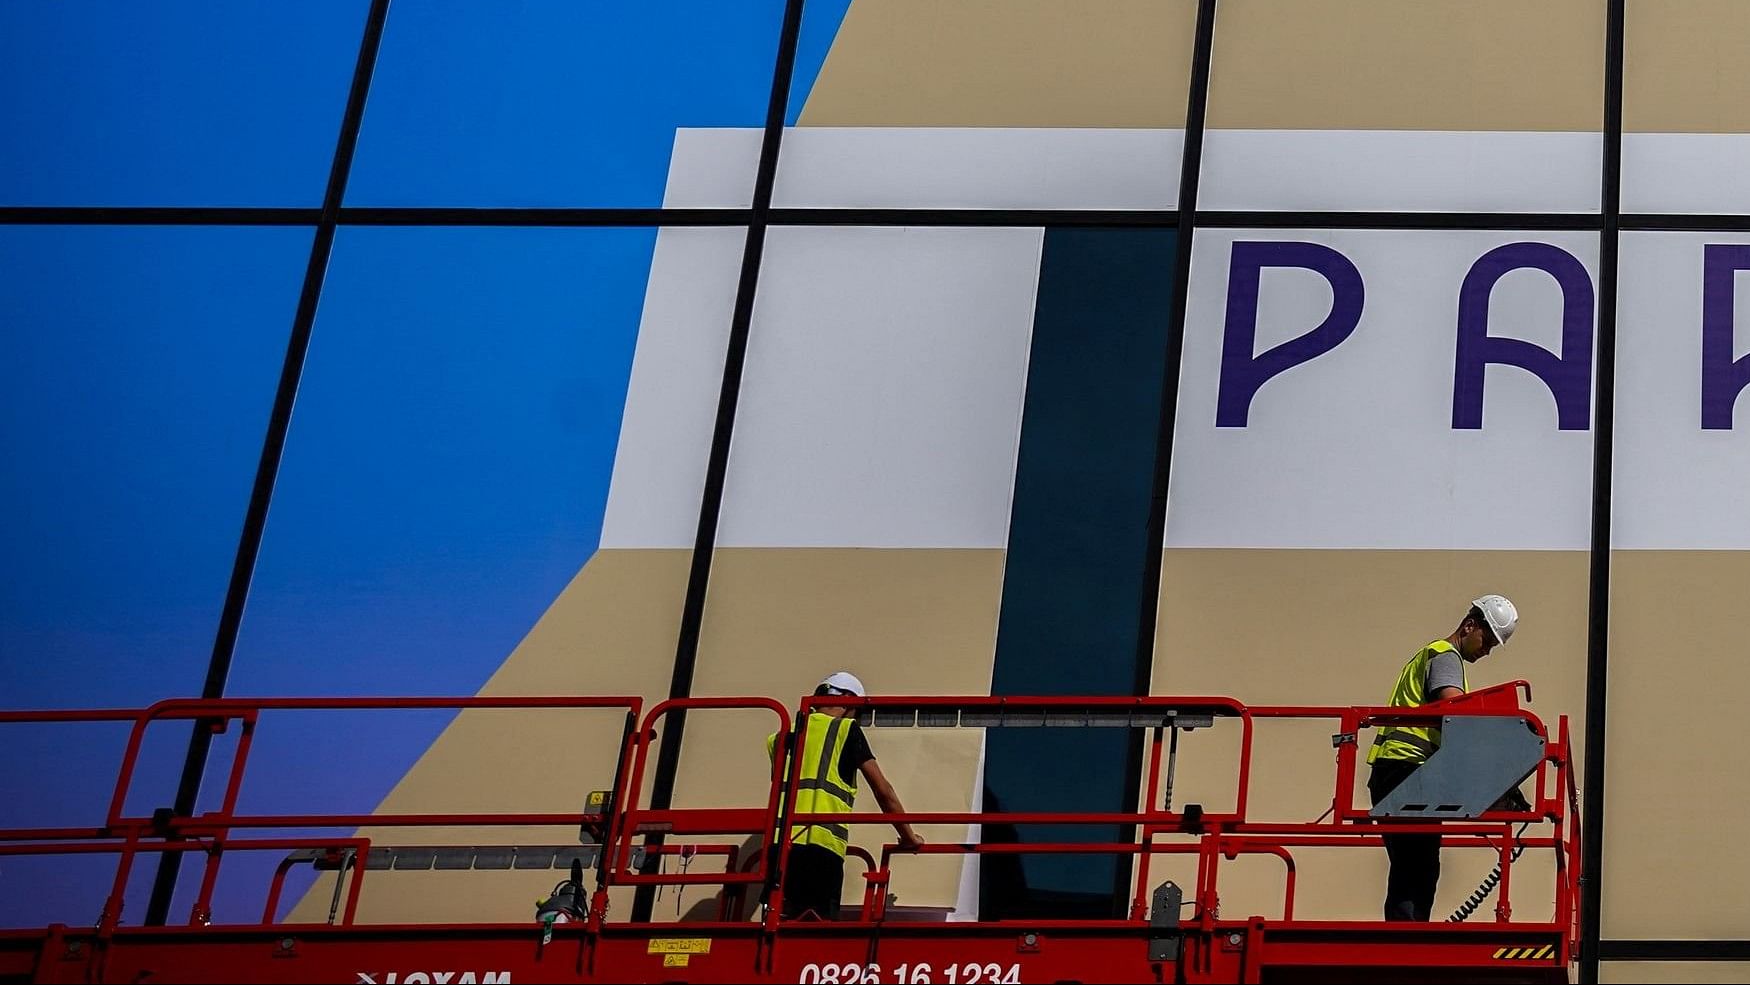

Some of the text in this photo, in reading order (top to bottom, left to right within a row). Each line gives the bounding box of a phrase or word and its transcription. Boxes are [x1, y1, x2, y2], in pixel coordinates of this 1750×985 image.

[799, 962, 1022, 984] 0826 16 1234
